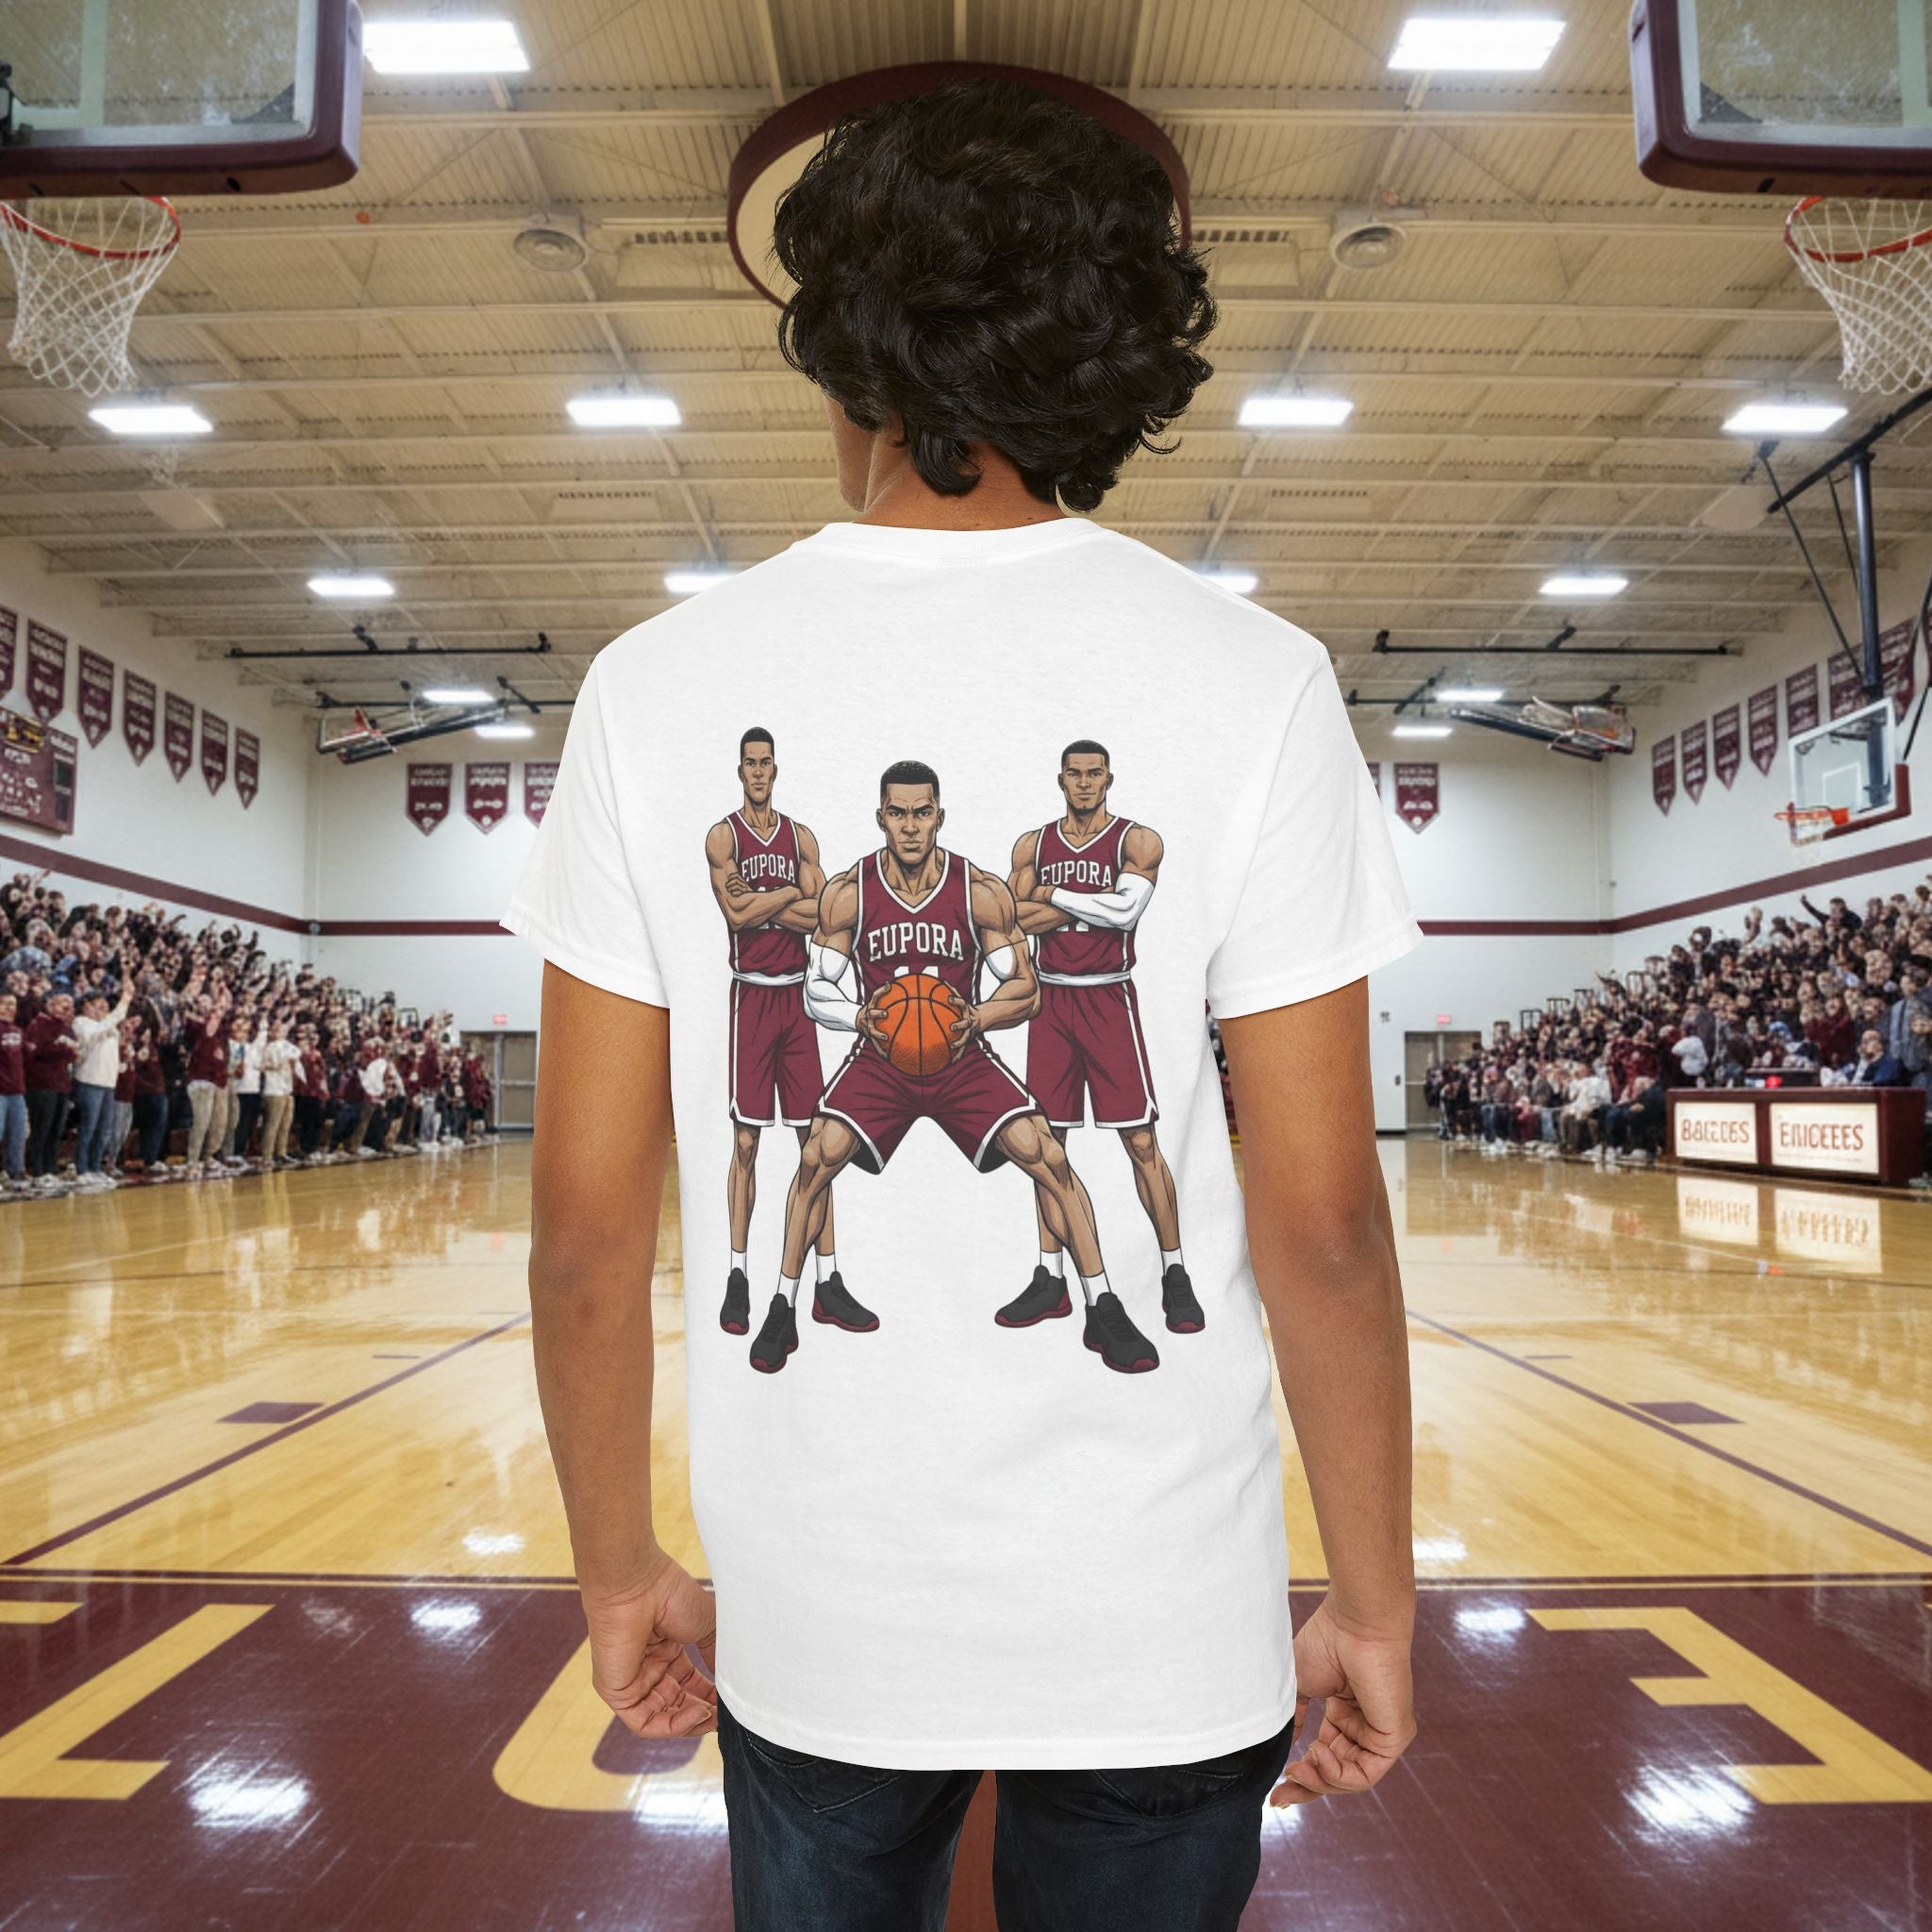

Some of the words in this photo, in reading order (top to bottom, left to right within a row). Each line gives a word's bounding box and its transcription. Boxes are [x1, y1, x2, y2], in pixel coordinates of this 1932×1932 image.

[741, 854, 795, 883] EUPORA
[1041, 860, 1111, 887] EUPORA
[868, 922, 964, 962] EUPORA
